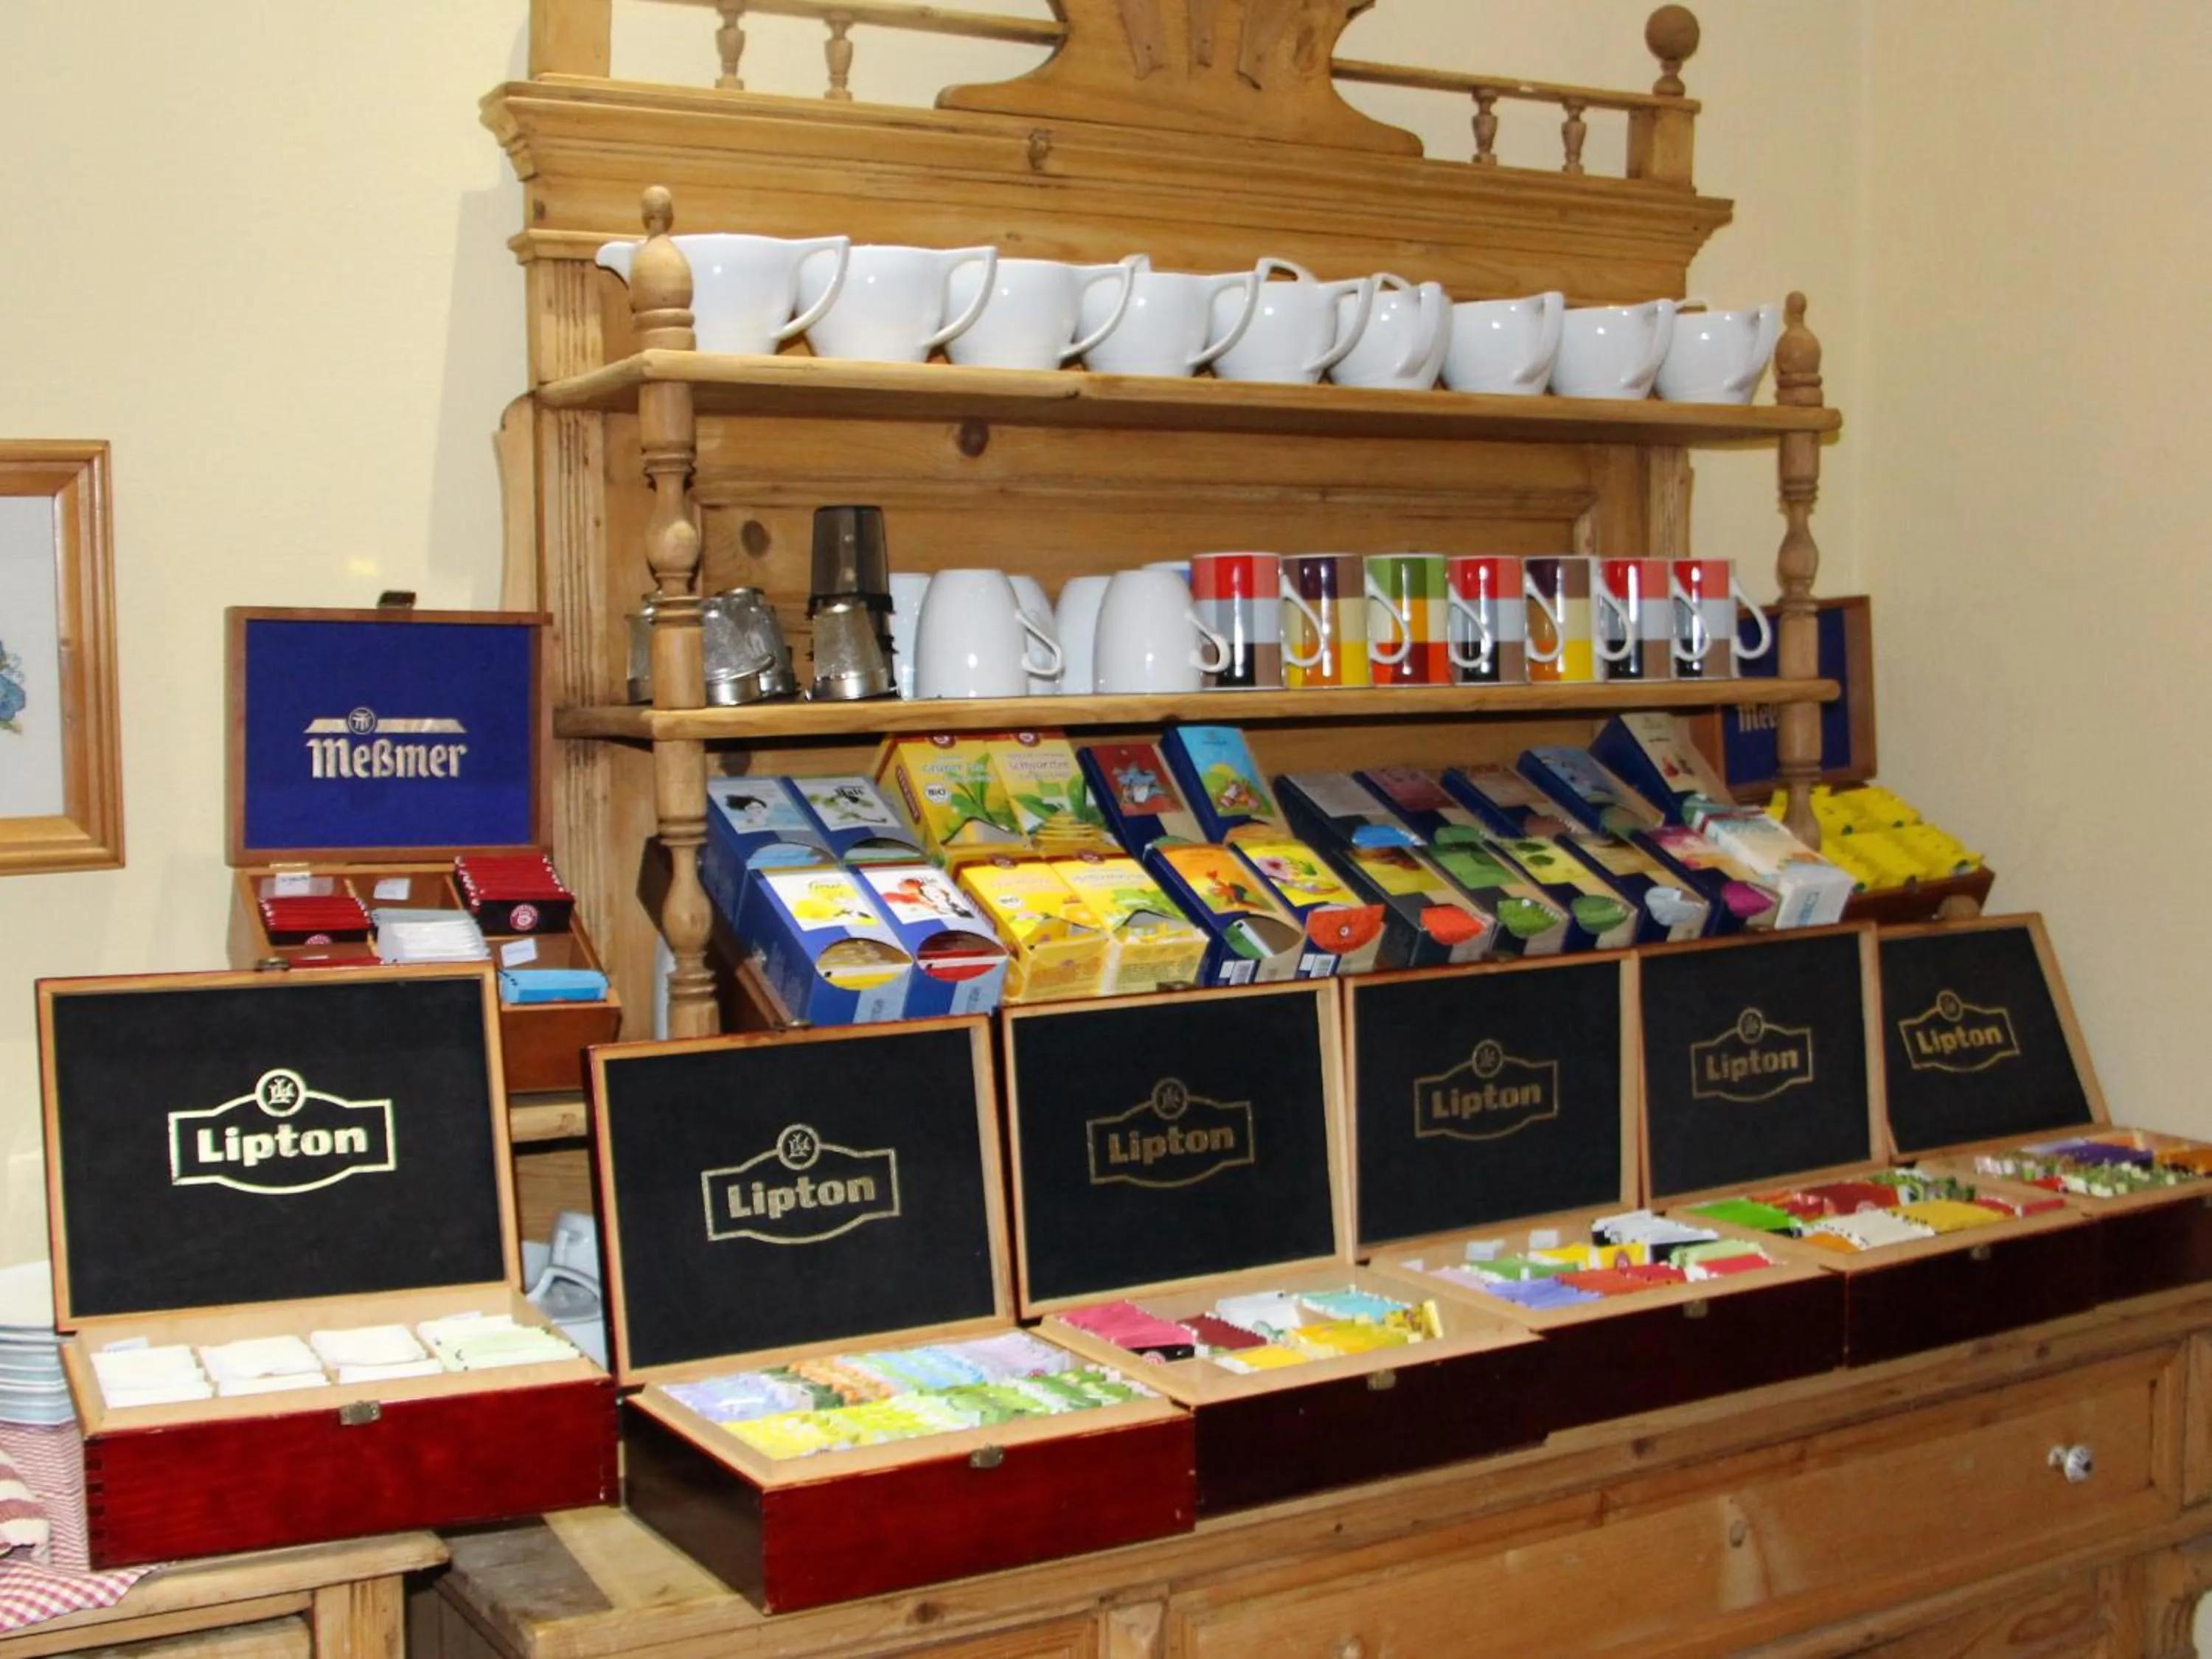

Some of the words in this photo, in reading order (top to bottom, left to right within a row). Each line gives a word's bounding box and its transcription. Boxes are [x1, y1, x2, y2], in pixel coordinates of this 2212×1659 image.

[306, 738, 467, 779] Meßmer
[1916, 1025, 2003, 1054] Lipton
[1705, 1049, 1798, 1082] Lipton
[1431, 1083, 1541, 1119] Lipton
[198, 1124, 367, 1166] Lipton
[1108, 1126, 1234, 1166] Lipton
[727, 1176, 875, 1220] Lipton
